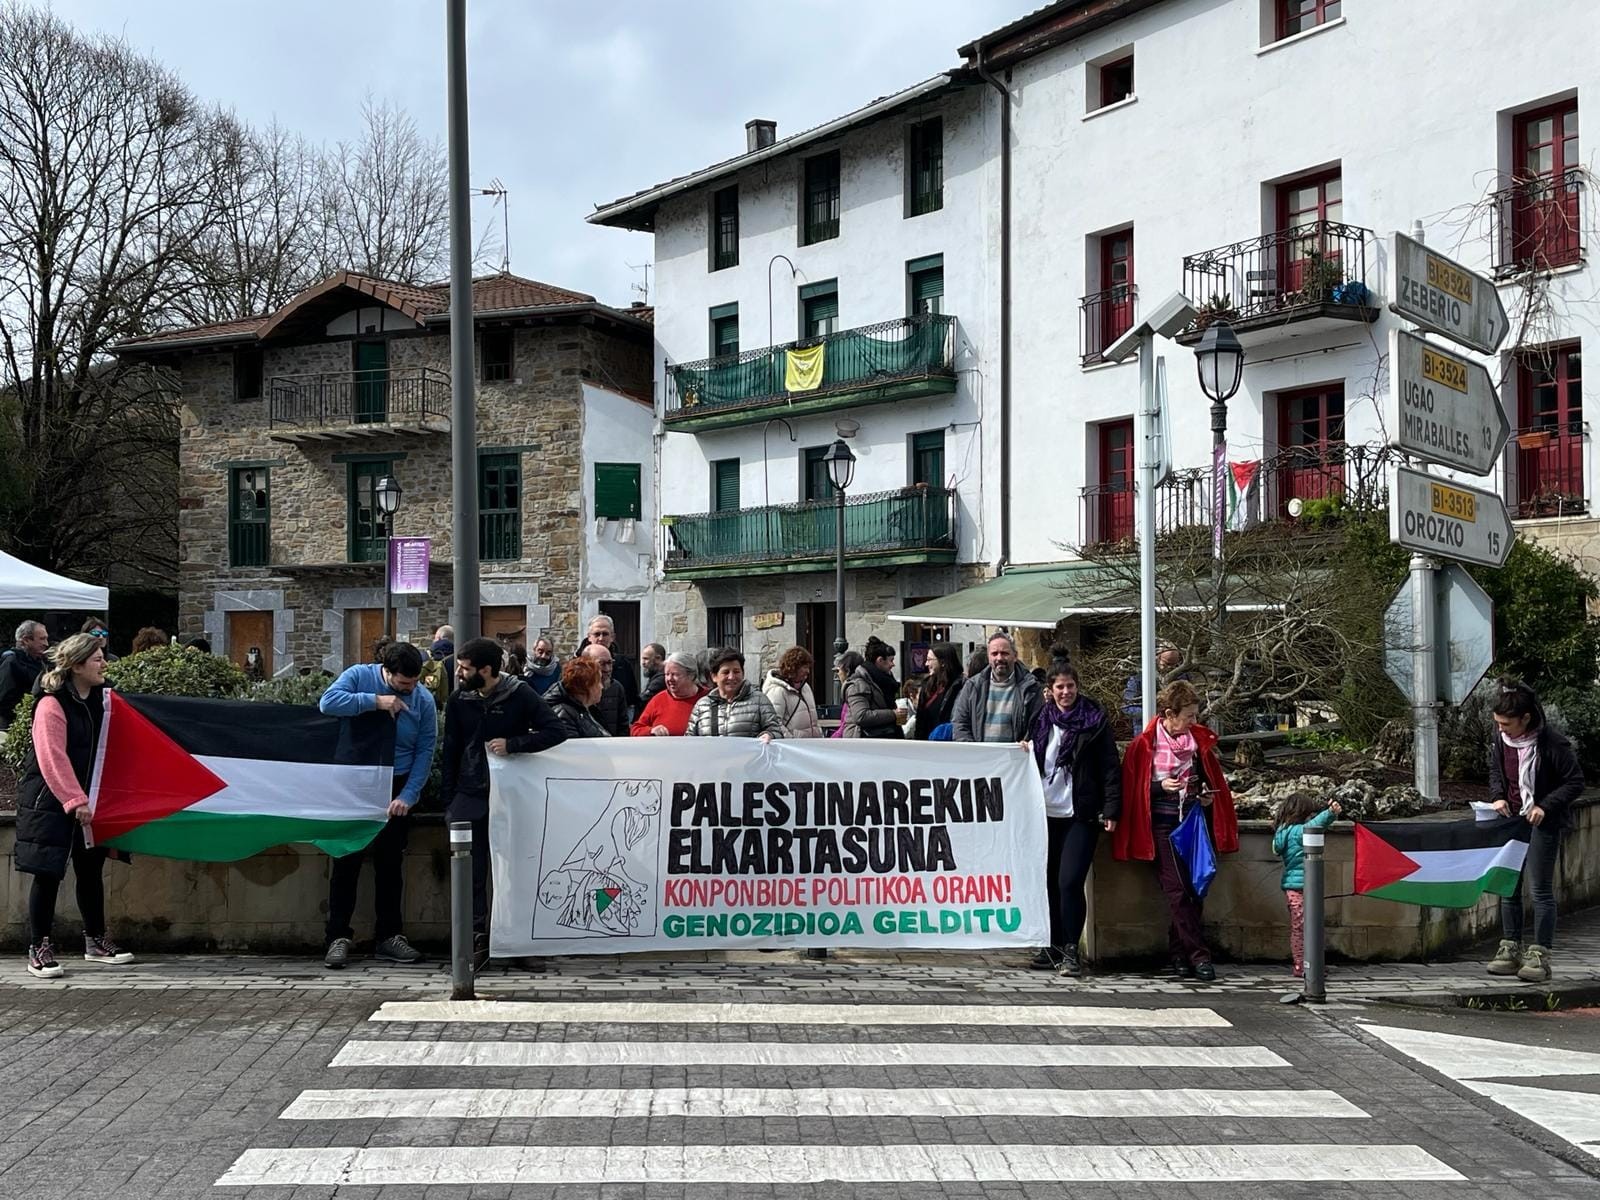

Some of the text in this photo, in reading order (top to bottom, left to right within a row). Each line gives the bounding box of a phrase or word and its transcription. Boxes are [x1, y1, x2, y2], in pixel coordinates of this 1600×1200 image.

[1428, 262, 1472, 300] BI-3524
[1402, 276, 1461, 326] ZEBERIO
[1487, 317, 1495, 341] 7
[1423, 352, 1467, 389] BI-3524
[1404, 379, 1434, 413] UGAO
[1404, 412, 1470, 459] MIRABALLES
[1482, 426, 1492, 450] 13
[1432, 489, 1474, 517] BI-3513
[1405, 510, 1464, 548] OROZKO
[1487, 530, 1500, 556] 15
[669, 777, 1004, 827] PALESTINAREKIN
[666, 825, 957, 876] ELKARTASUNA
[663, 874, 1012, 908] KONPONBIDE POLITIKOA ORAIN!
[662, 907, 1022, 939] GENOZIDIOA GELDITU
